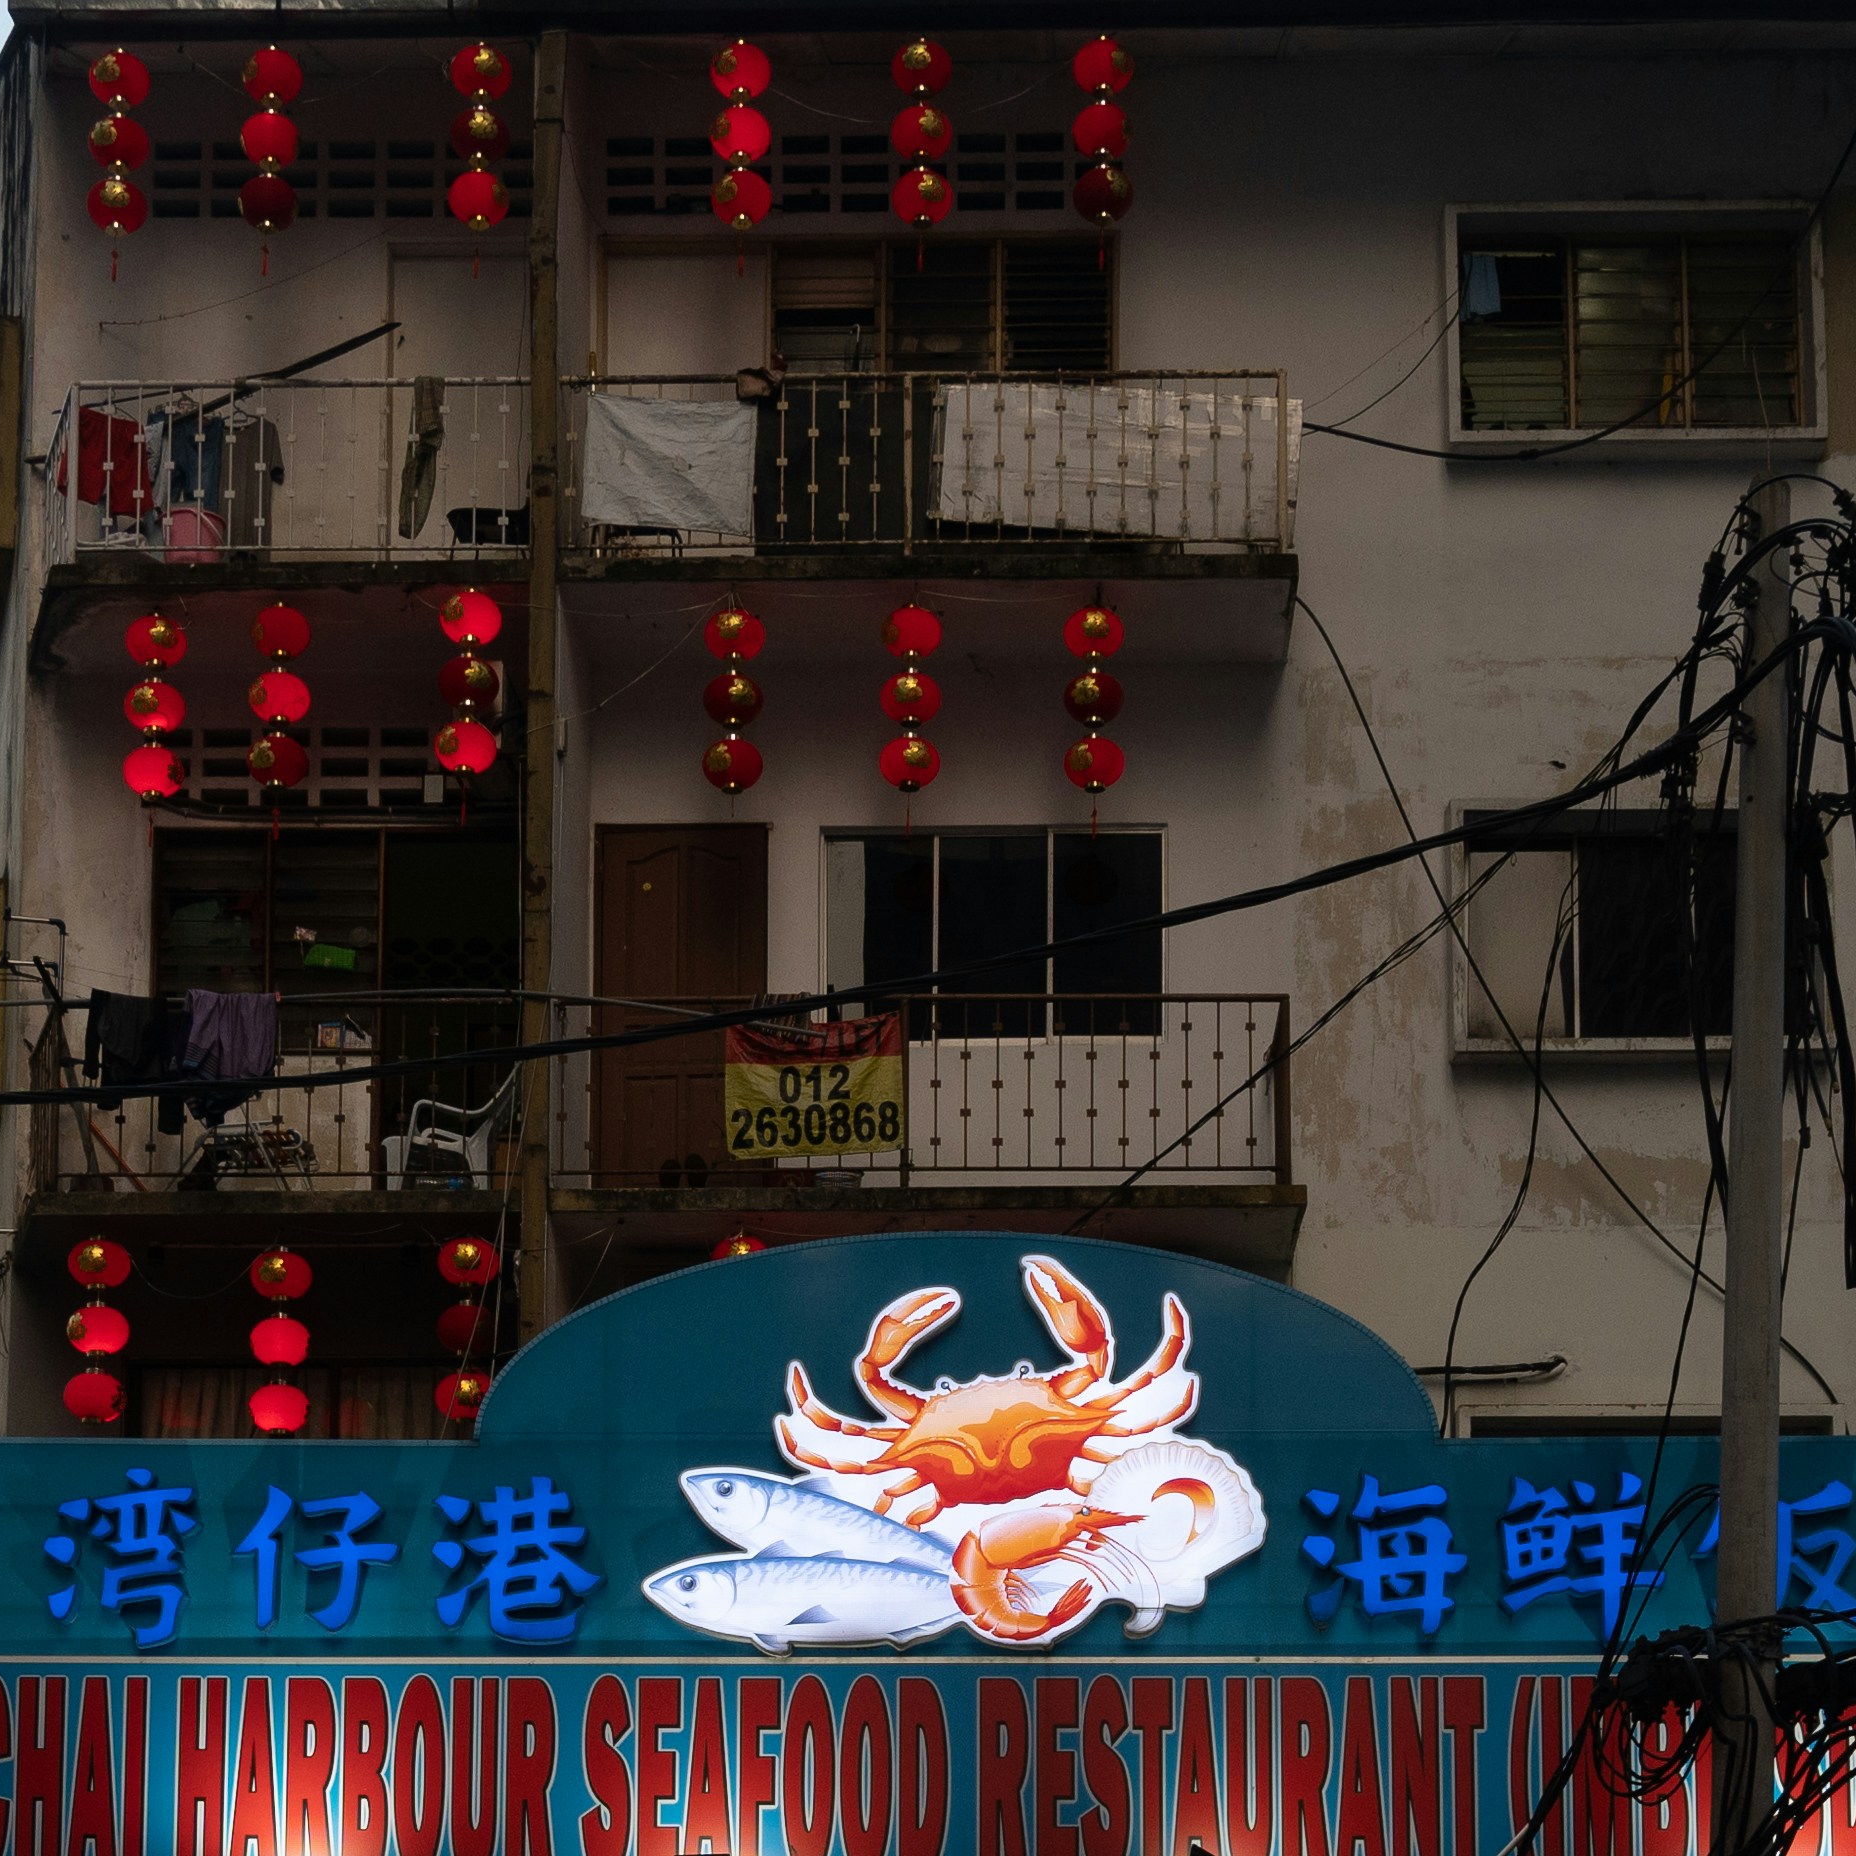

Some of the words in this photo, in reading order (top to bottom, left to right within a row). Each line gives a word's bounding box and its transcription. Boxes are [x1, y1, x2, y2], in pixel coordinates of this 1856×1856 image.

[779, 1064, 851, 1105] 012
[730, 1101, 901, 1150] 2630868
[42, 1467, 603, 1649] 湾仔港
